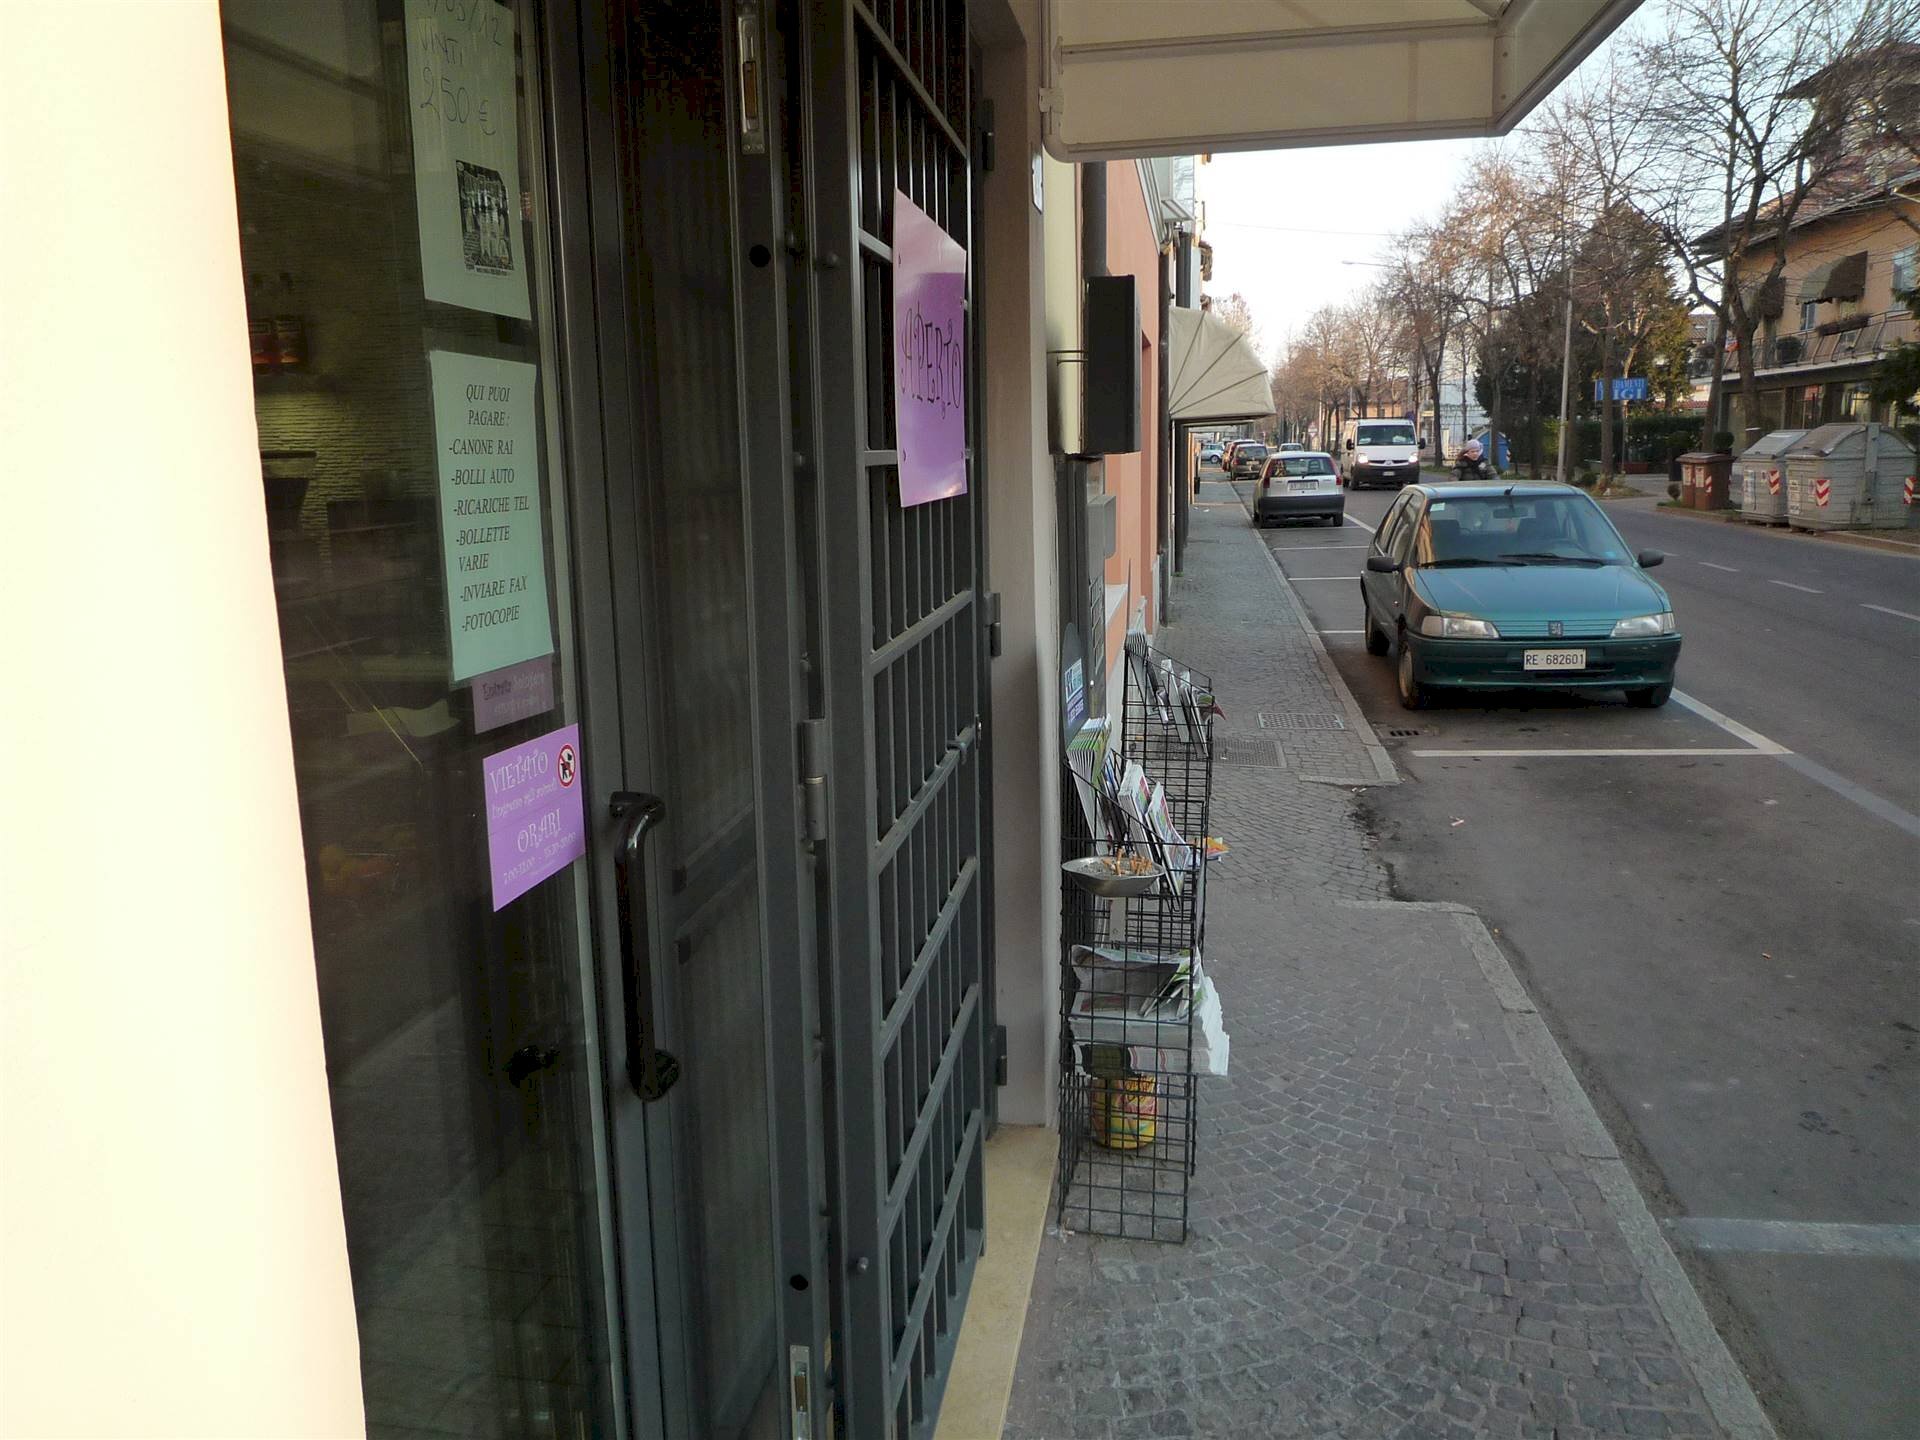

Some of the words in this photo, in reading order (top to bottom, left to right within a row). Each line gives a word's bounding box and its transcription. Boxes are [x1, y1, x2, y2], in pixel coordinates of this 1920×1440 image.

[420, 66, 470, 124] 250
[479, 99, 497, 136] €
[901, 300, 962, 420] APERTO
[466, 383, 485, 403] QUI
[488, 386, 511, 402] PUOI
[448, 438, 494, 455] -CANONE
[497, 439, 514, 455] RAI
[451, 468, 486, 486] -BOLLI
[490, 468, 515, 484] AUTO
[453, 496, 510, 516] -RICARICHE
[514, 495, 530, 511] TEL
[456, 525, 511, 546] -BOLLETTE
[458, 553, 490, 573] VARIE
[460, 579, 506, 602] -INVIARE
[509, 575, 528, 593] FAX
[461, 605, 520, 632] -FOTOCOPIE
[1525, 654, 1539, 665] RE
[1546, 653, 1584, 665] 682601
[489, 749, 548, 794] VIETATO
[517, 808, 562, 852] ORARI
